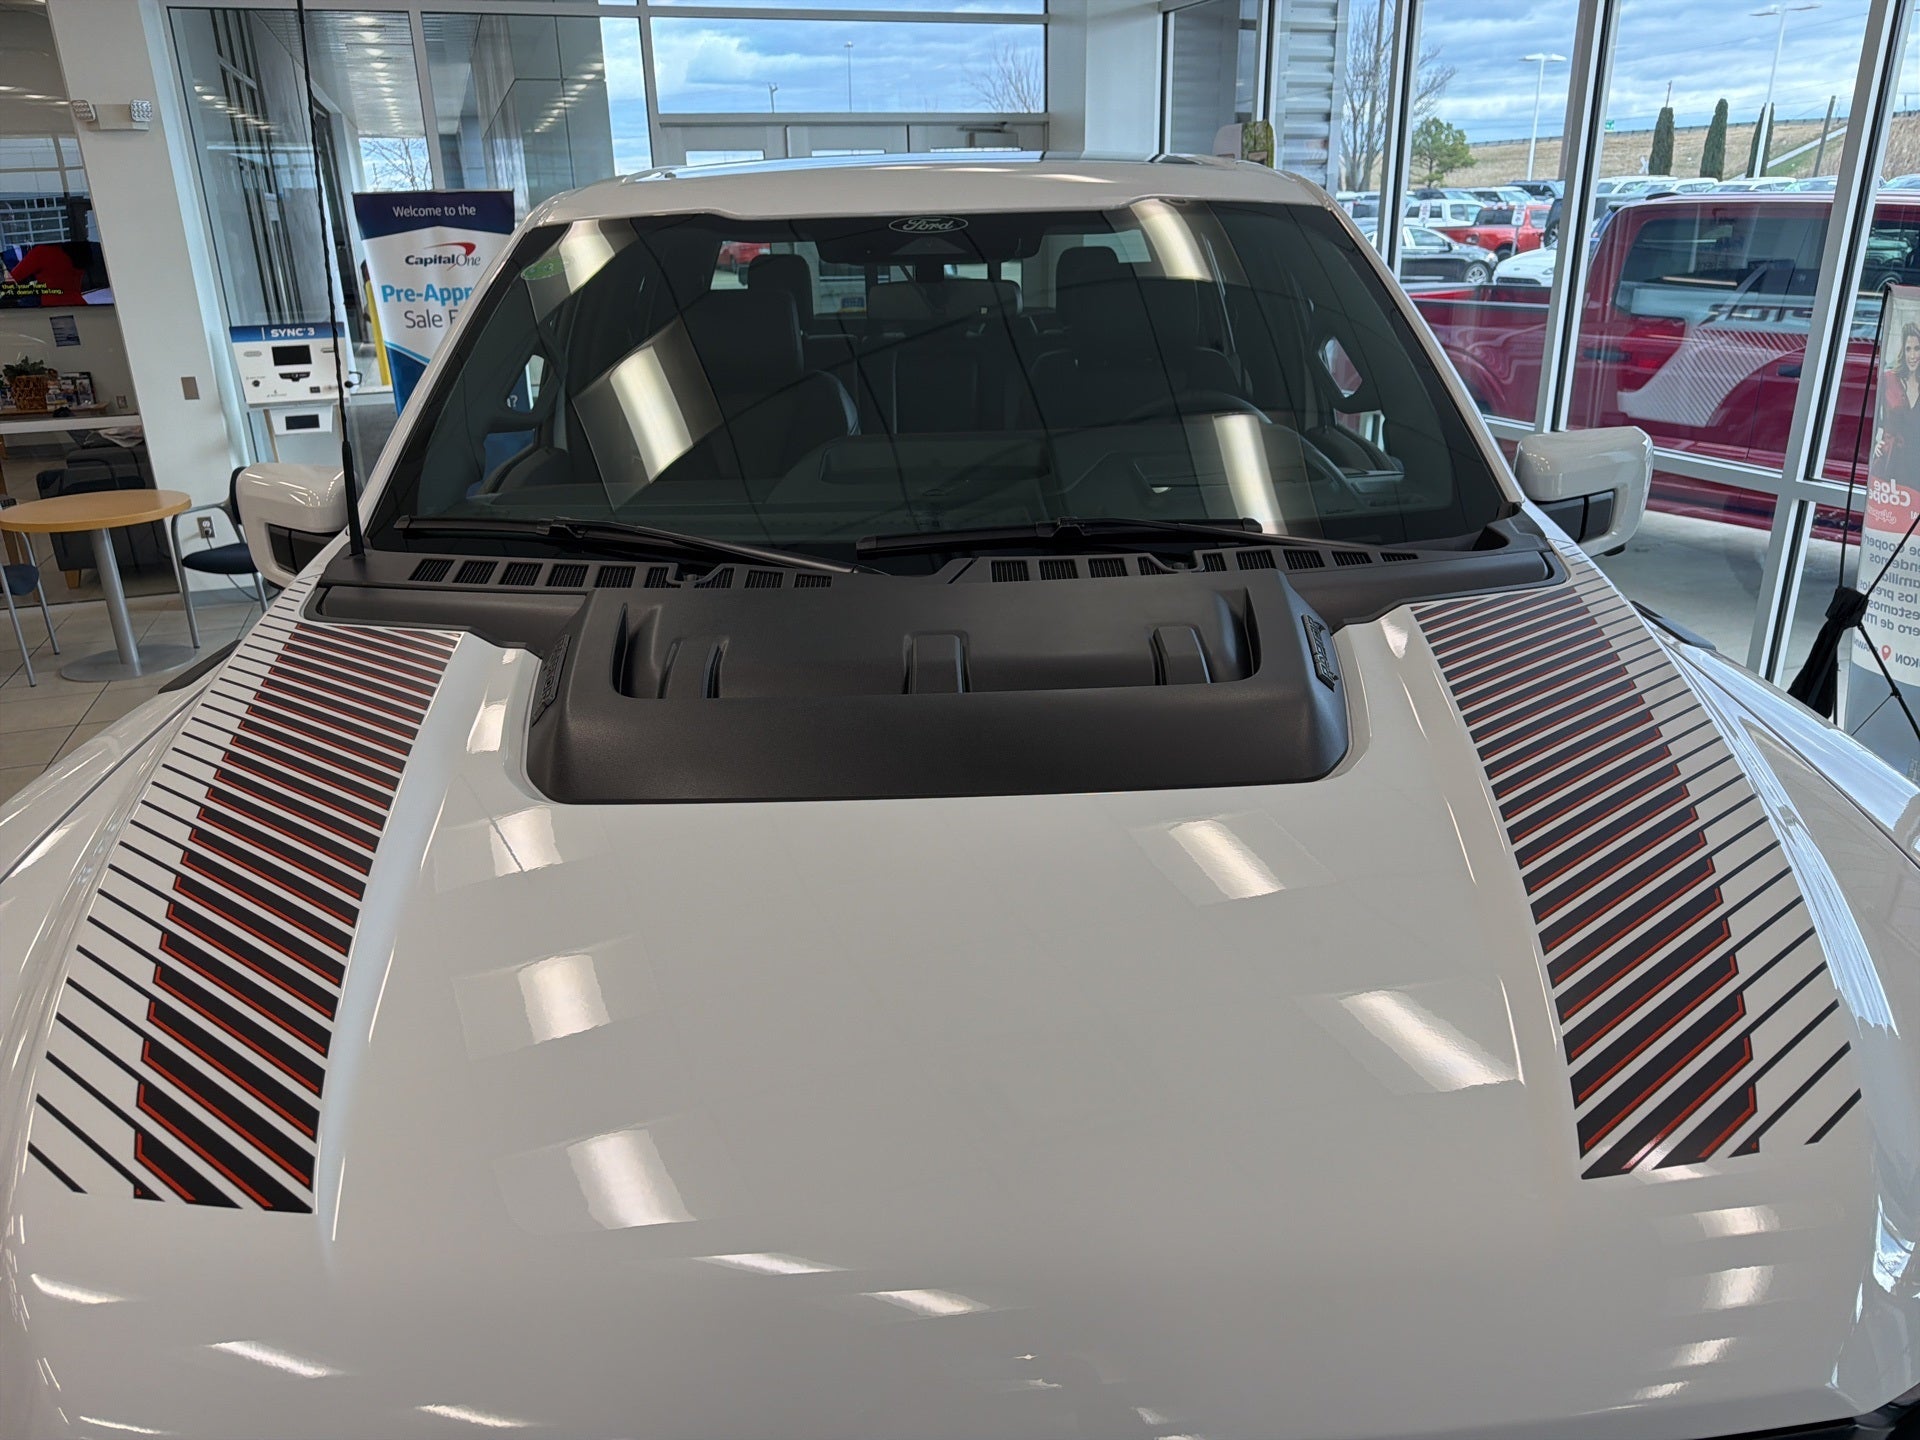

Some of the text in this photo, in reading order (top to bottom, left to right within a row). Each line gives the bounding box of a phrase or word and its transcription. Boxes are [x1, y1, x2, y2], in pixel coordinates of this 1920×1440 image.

[392, 204, 476, 218] Welcome to the
[902, 218, 954, 231] Ford
[381, 283, 472, 307] Pre-Appr
[403, 308, 444, 329] Sale
[307, 327, 315, 336] 3
